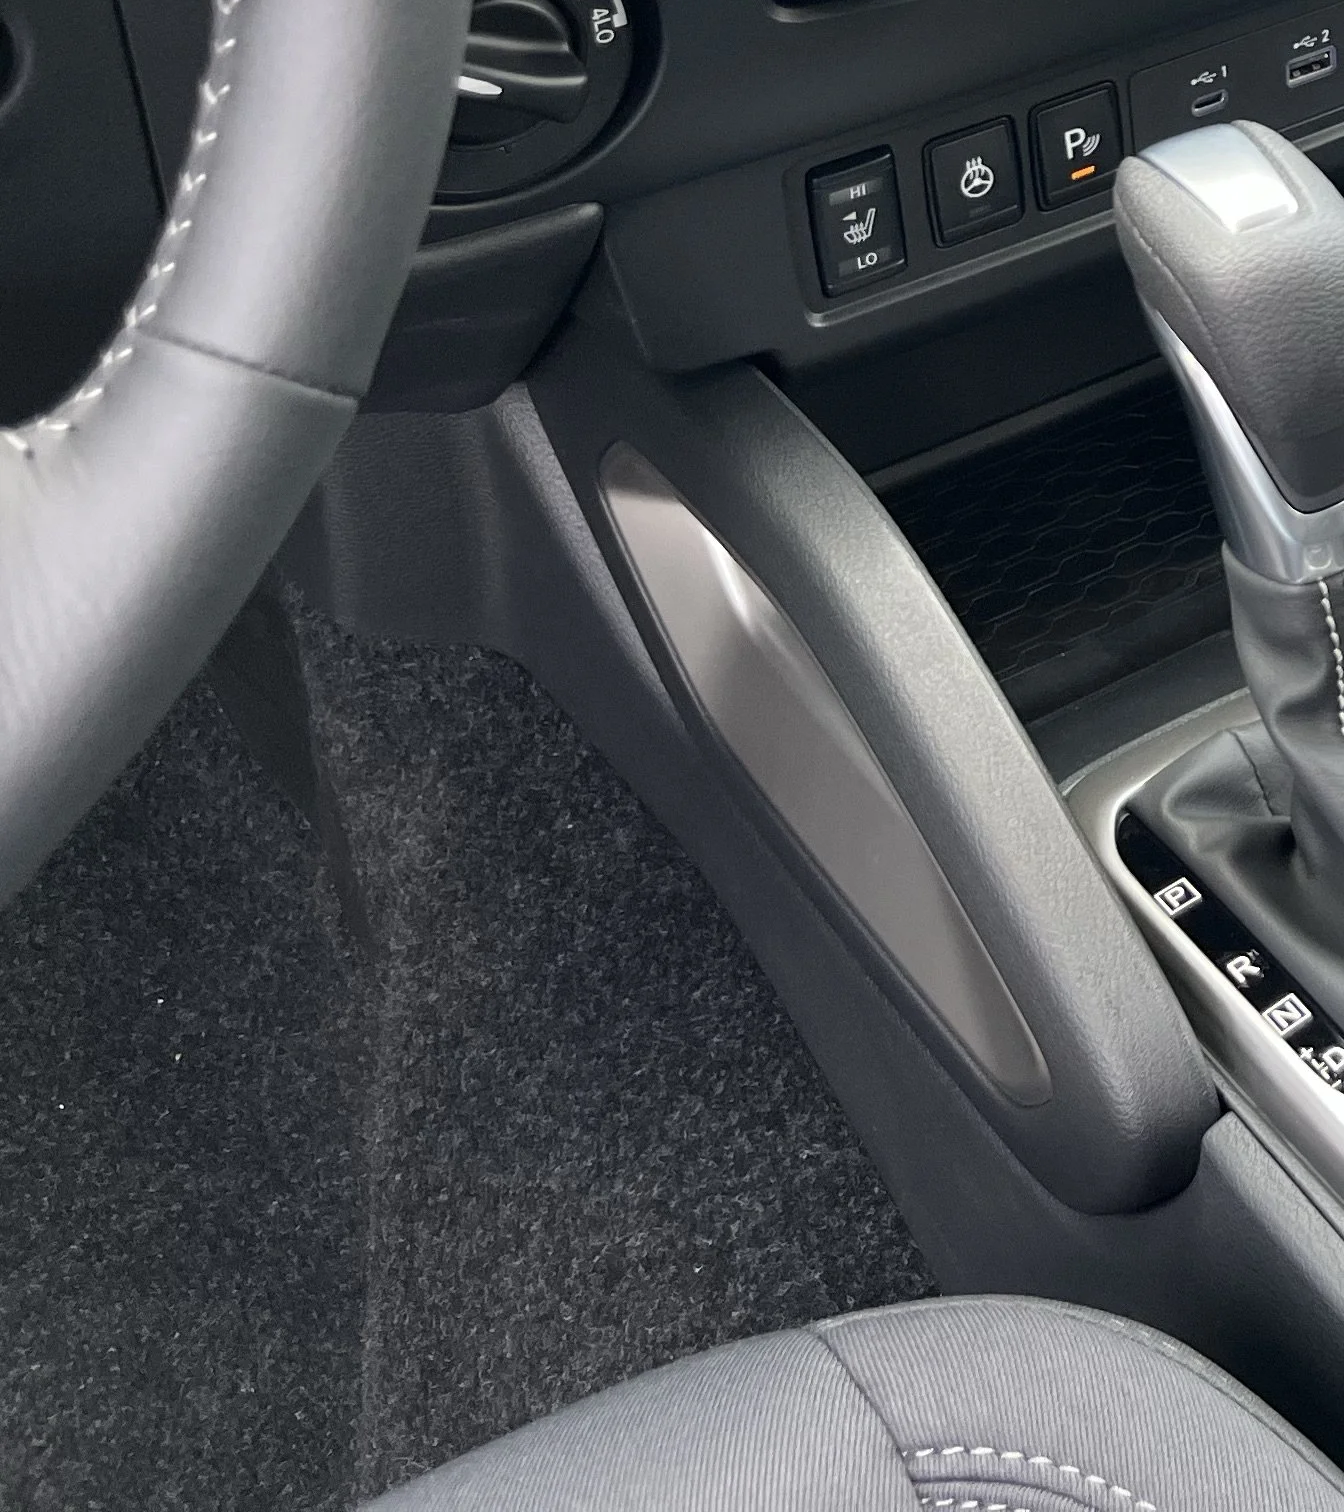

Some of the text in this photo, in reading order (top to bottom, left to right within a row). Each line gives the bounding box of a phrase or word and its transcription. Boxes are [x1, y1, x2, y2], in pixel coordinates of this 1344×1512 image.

[591, 7, 616, 44] 4LO
[1320, 29, 1332, 44] 2
[1220, 65, 1228, 81] 1
[848, 182, 868, 199] HI
[856, 251, 879, 270] LO
[1164, 886, 1185, 908] P
[1226, 954, 1261, 983] R
[1273, 1000, 1303, 1028] N
